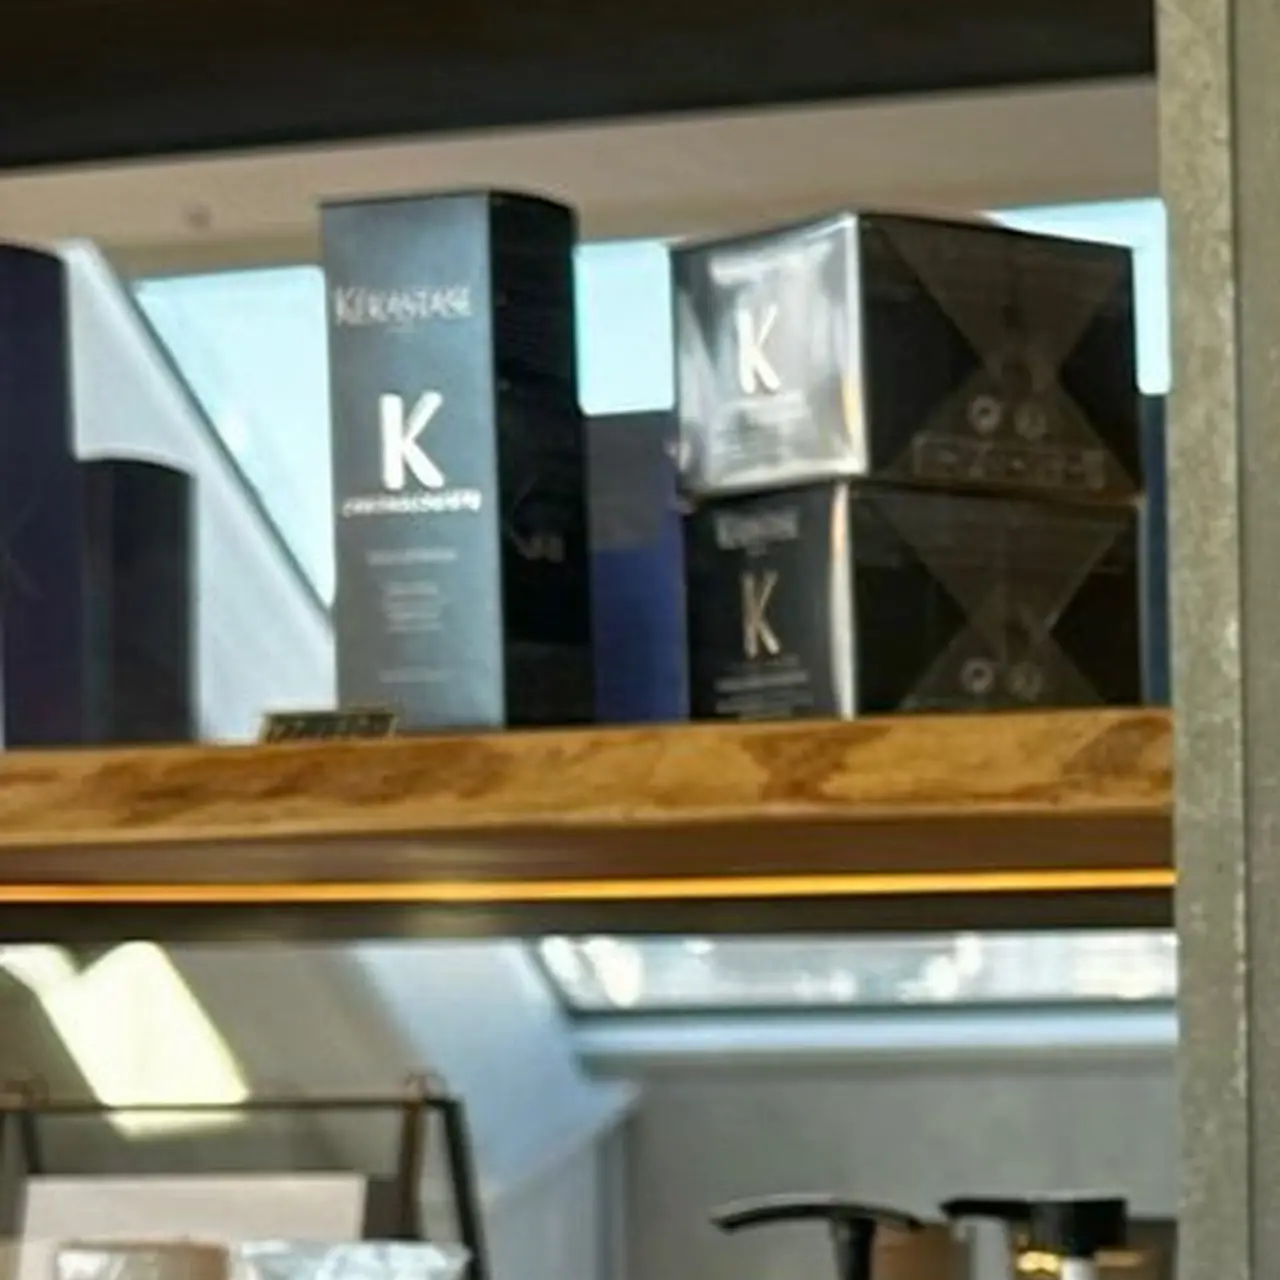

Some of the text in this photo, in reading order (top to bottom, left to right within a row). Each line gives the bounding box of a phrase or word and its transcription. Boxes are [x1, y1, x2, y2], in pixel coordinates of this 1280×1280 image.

[737, 304, 782, 395] K
[379, 390, 445, 490] K
[740, 570, 781, 658] K
